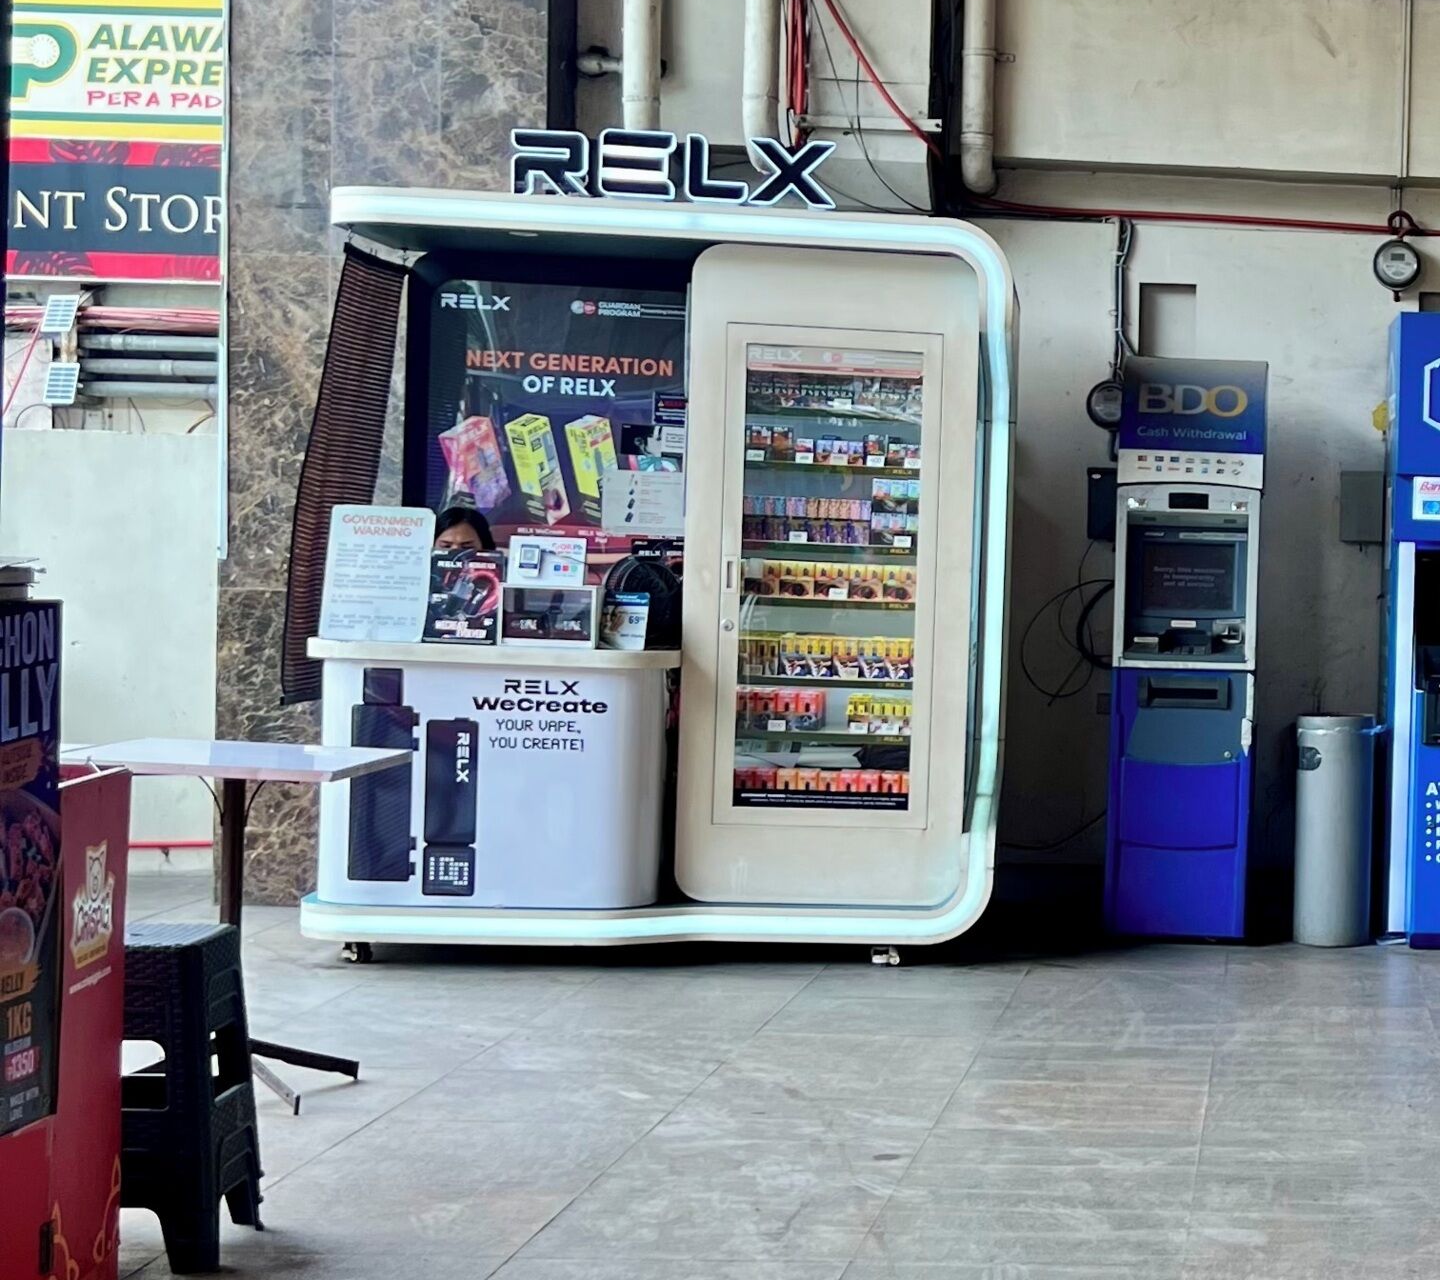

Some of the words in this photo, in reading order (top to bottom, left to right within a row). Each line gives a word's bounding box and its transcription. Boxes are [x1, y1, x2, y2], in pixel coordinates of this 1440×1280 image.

[511, 128, 837, 210] RELX
[441, 293, 511, 311] RELX
[748, 347, 802, 362] RELX
[466, 350, 524, 370] NEXT
[530, 352, 673, 377] GENERATION
[523, 375, 554, 395] OF
[560, 376, 616, 397] RELX
[1138, 383, 1248, 417] BDO
[1137, 426, 1169, 437] Cash
[1172, 427, 1247, 441] Withdrawal
[342, 514, 424, 527] GOVERNMENT
[354, 525, 412, 537] WARNING
[504, 679, 580, 696] RELX
[472, 697, 608, 713] WeCreate
[496, 719, 533, 731] YOUR
[538, 720, 581, 734] VAPE,
[489, 737, 517, 749] YOU
[522, 738, 584, 751] CREATE!
[456, 732, 470, 783] RELX
